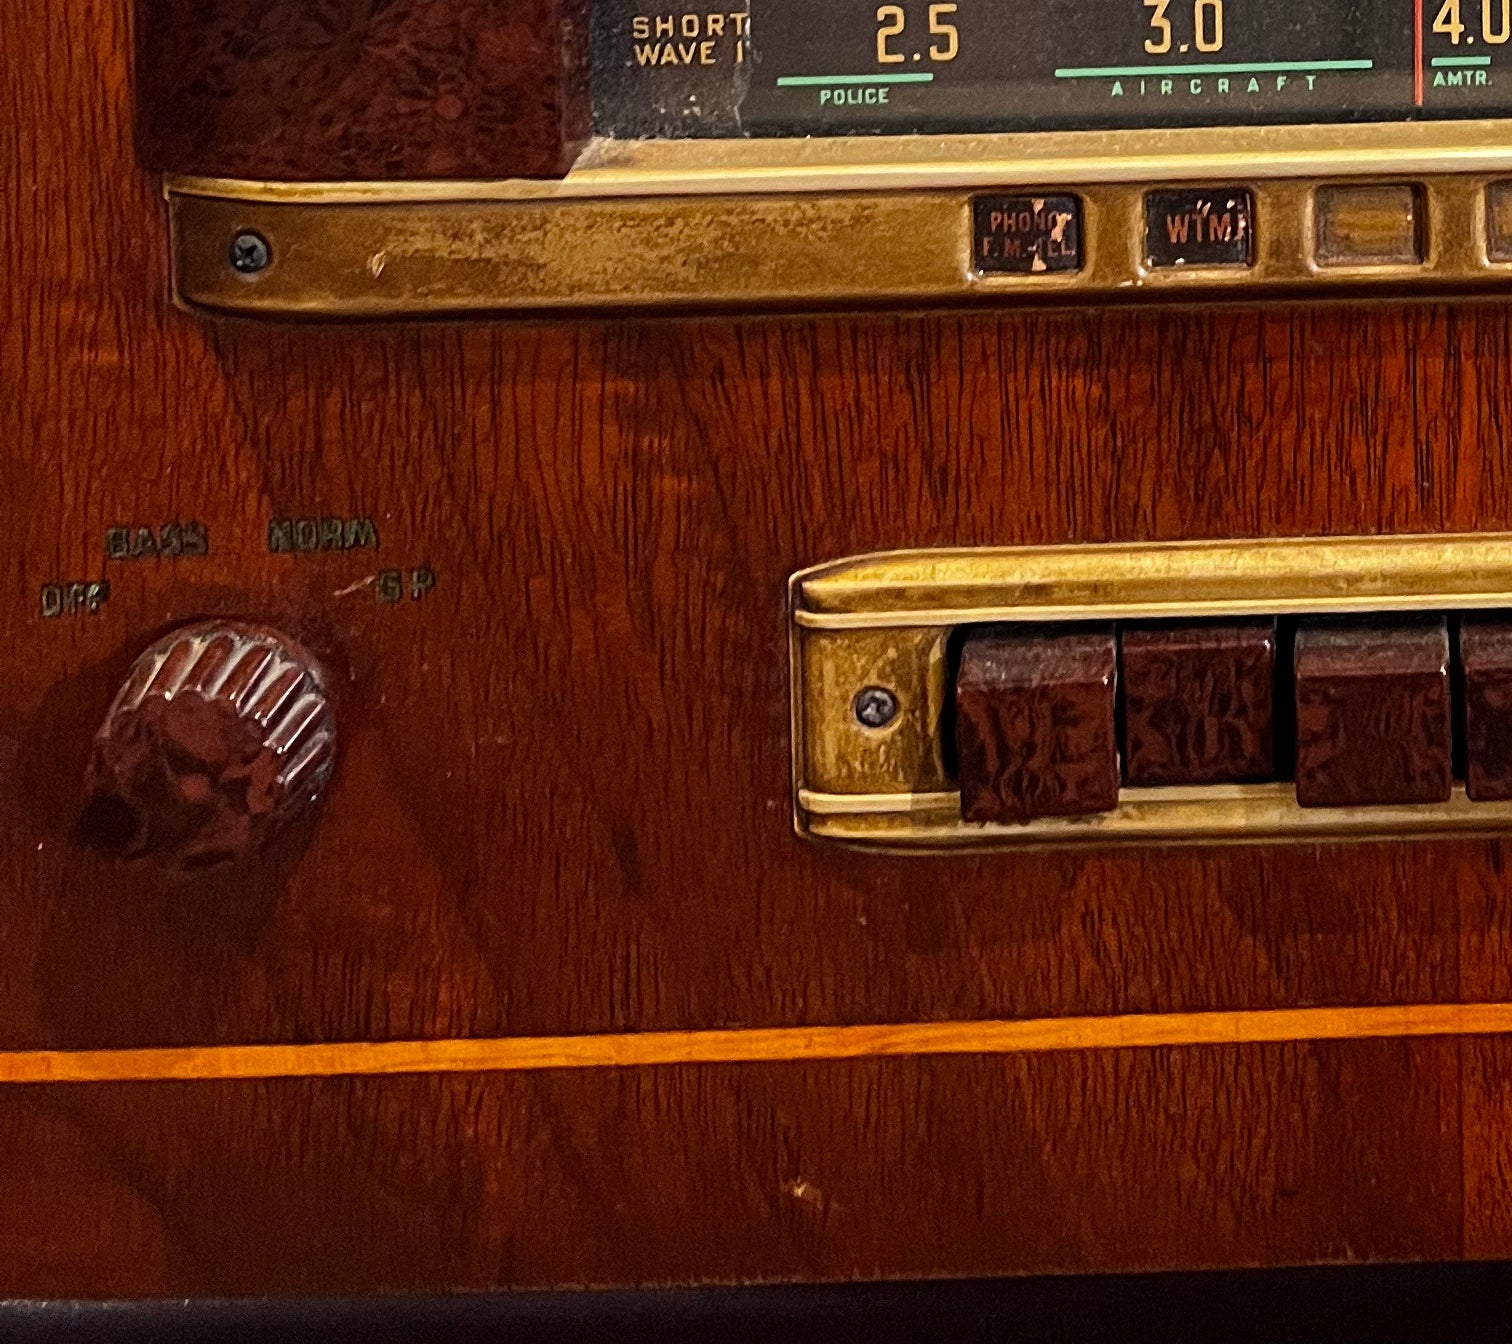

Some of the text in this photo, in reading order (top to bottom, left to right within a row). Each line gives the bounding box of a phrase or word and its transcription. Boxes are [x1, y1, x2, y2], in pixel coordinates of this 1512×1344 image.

[632, 13, 748, 39] SHORT
[876, 3, 961, 65] 2.5
[633, 40, 717, 66] WAVE
[1111, 74, 1318, 97] AIRCRAFT
[1433, 69, 1493, 87] AMTR.
[819, 87, 890, 105] POLICE
[267, 517, 379, 553] NORM
